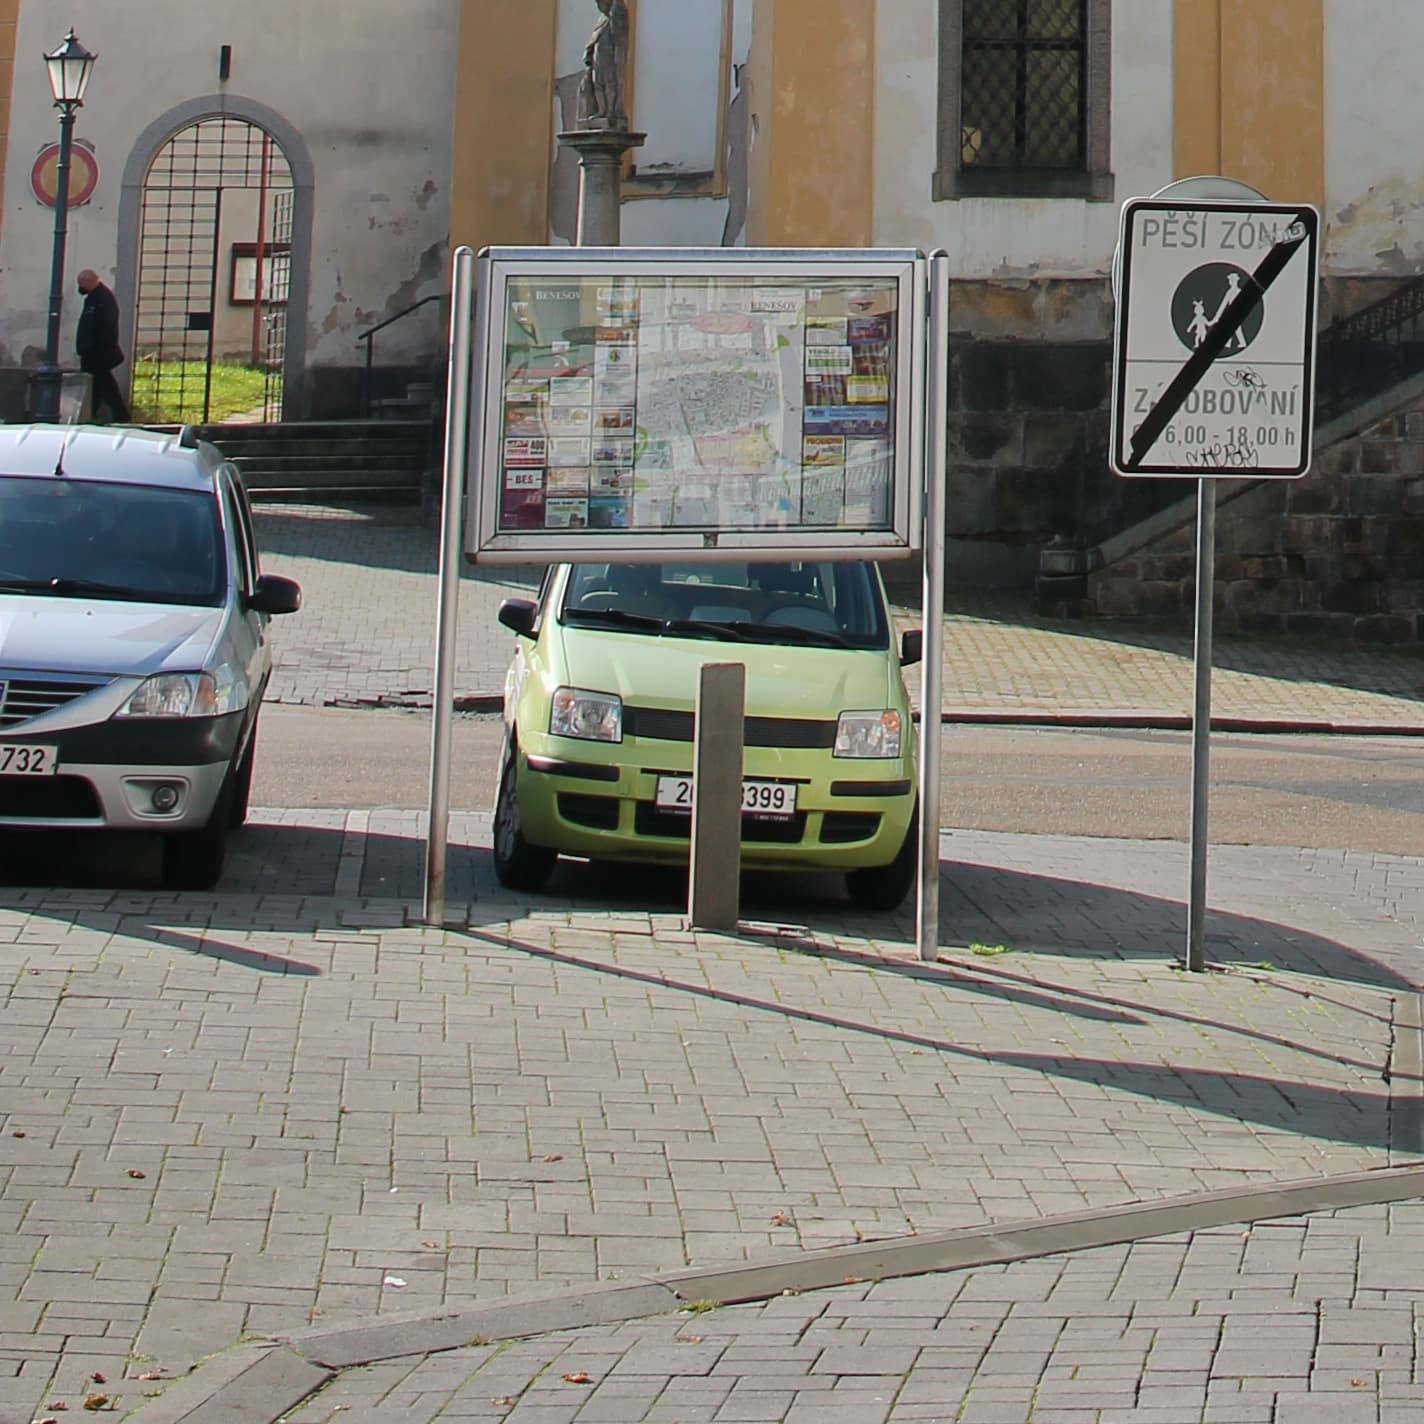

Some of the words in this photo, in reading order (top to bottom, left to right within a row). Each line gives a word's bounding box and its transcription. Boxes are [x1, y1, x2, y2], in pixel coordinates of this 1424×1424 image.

[1142, 210, 1208, 248] PĚŠÍ
[1219, 213, 1288, 250] ZÓN
[1165, 425, 1206, 447] 6,00
[1227, 426, 1278, 447] 18,00
[1285, 428, 1296, 445] h
[0, 747, 45, 772] 732
[741, 786, 785, 809] 399
